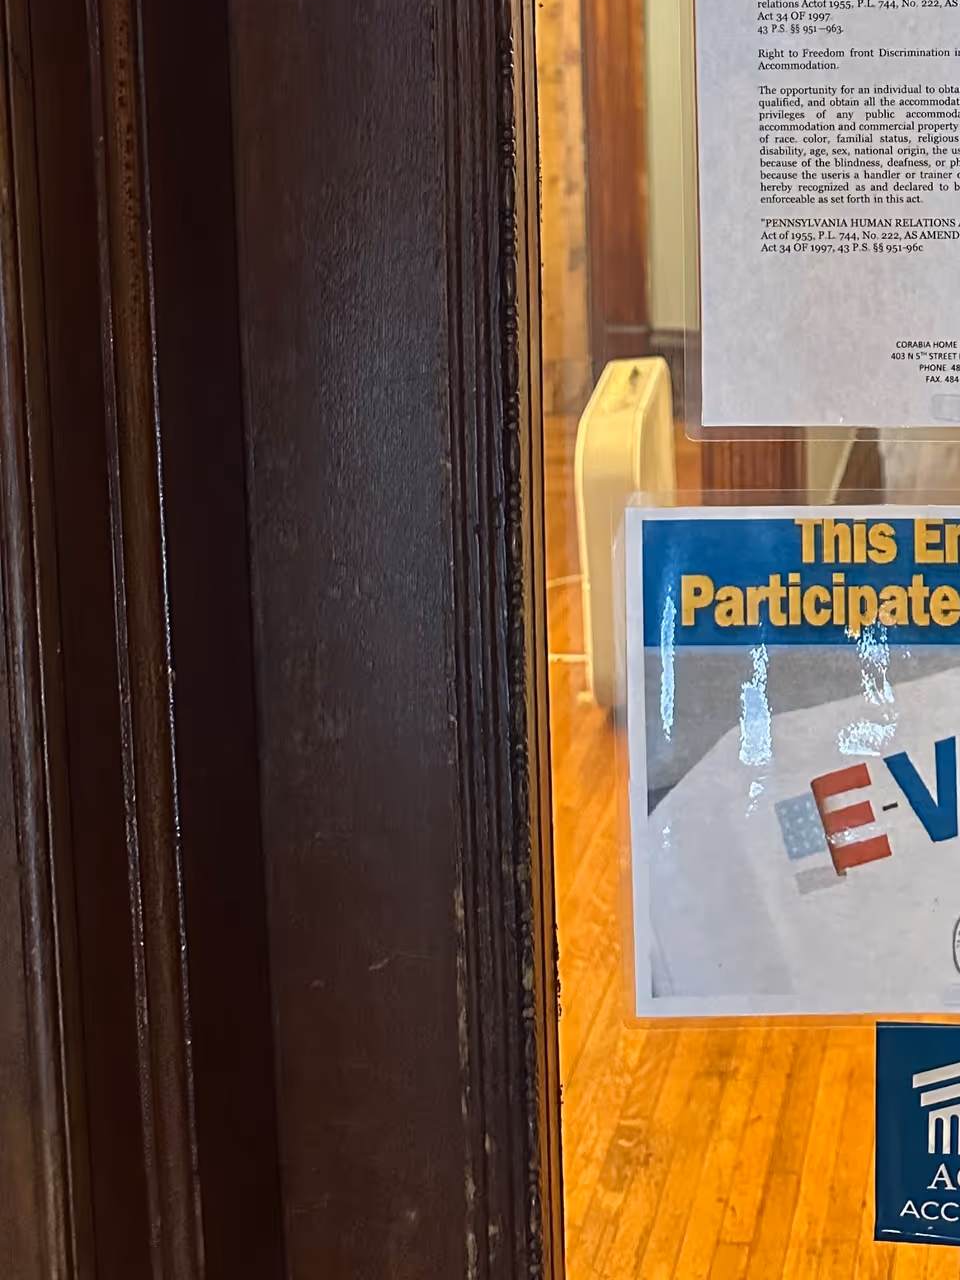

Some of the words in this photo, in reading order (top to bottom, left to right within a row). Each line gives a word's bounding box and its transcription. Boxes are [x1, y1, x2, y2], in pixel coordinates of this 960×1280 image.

[758, 48, 784, 60] Right
[788, 49, 798, 57] to
[802, 47, 844, 57] Freedom
[849, 47, 873, 57] front
[878, 48, 950, 57] Discrimination
[757, 60, 840, 70] Accommodation.
[850, 218, 892, 227] HUMAN
[895, 218, 955, 227] RELATIONS
[895, 340, 931, 348] CORABIA
[932, 340, 957, 348] HOME
[890, 352, 905, 360] 403
[928, 352, 957, 360] STREET
[795, 518, 895, 564] This
